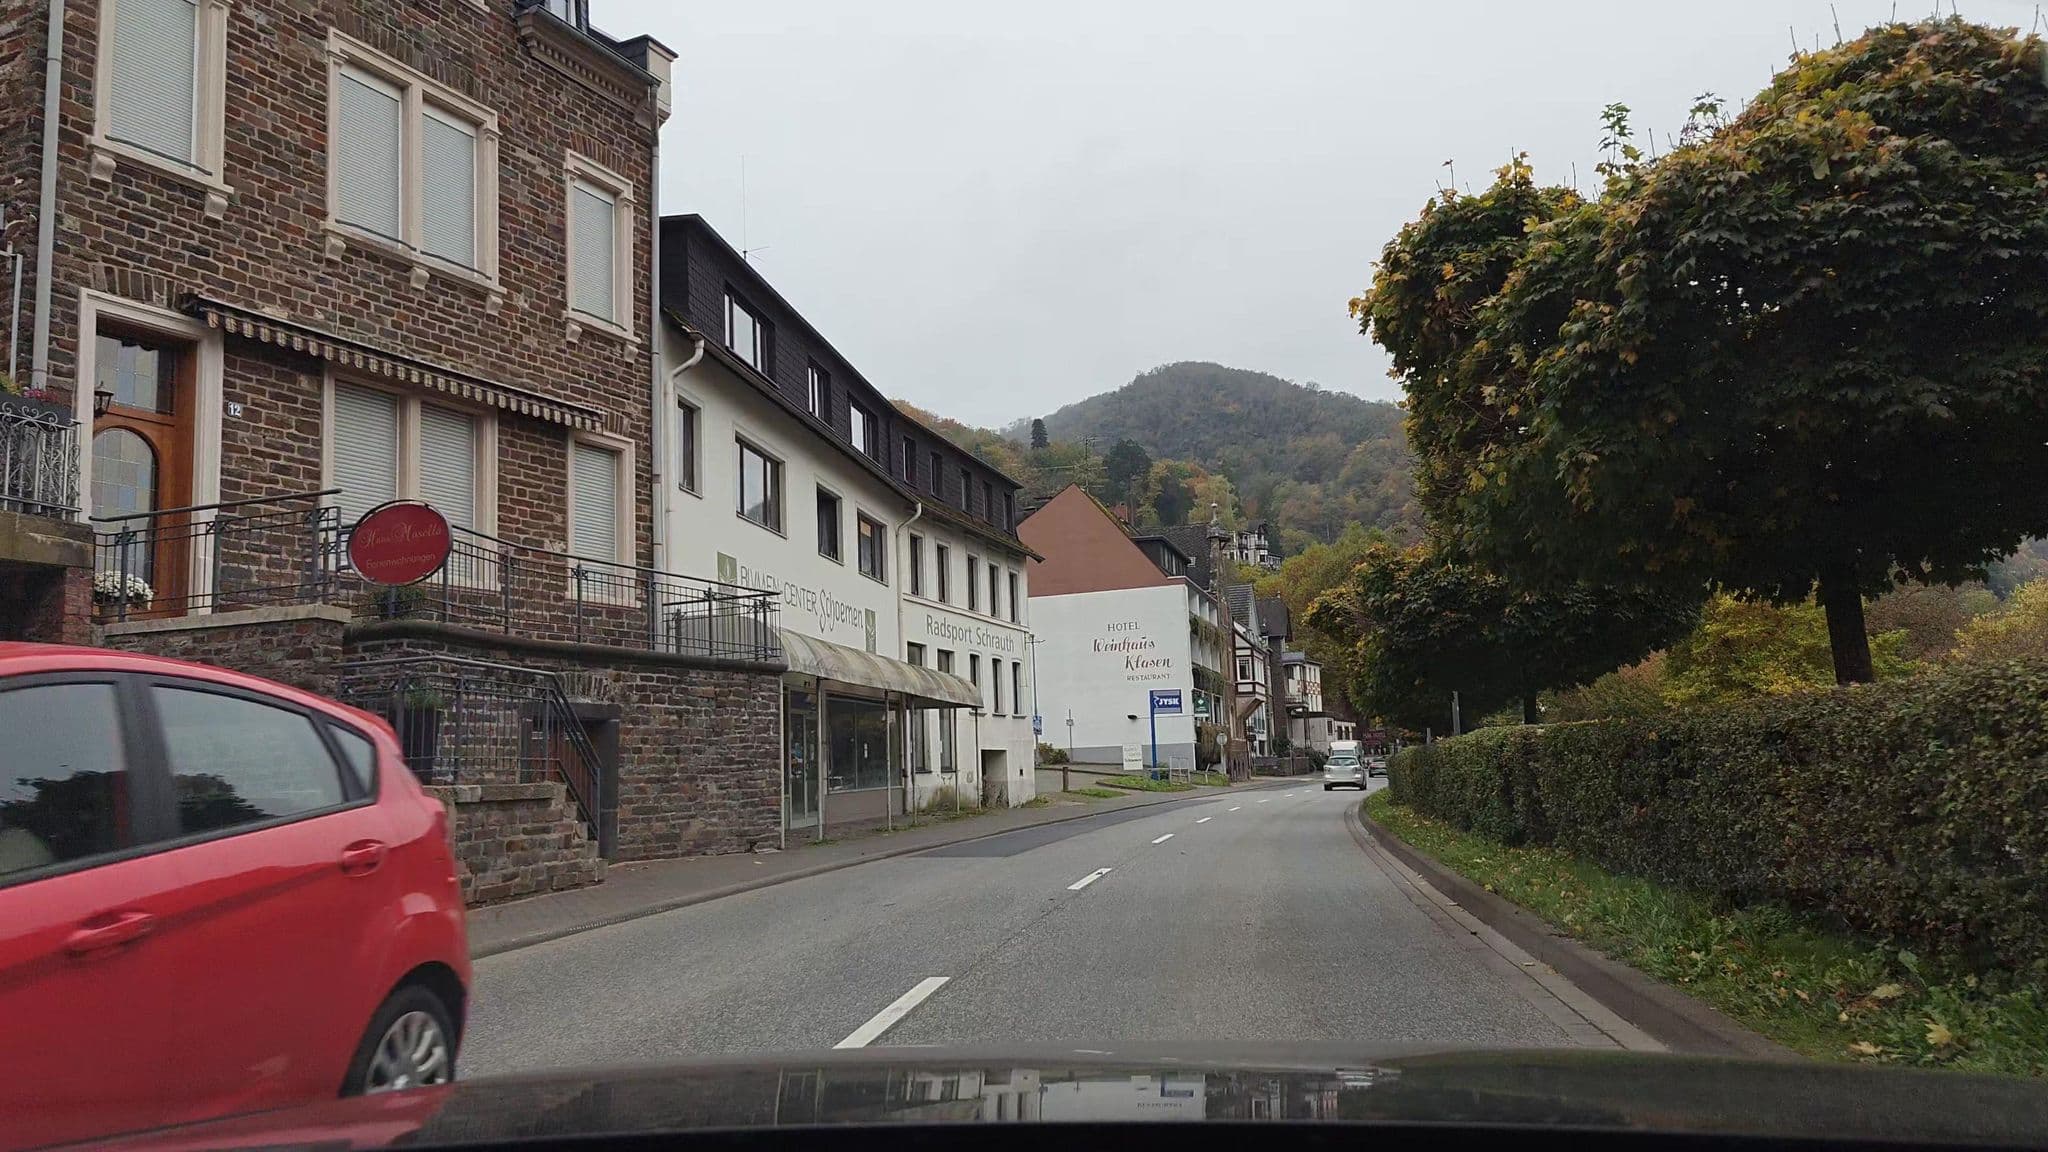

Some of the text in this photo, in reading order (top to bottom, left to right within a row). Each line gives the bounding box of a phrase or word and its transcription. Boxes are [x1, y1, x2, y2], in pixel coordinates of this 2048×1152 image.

[230, 403, 241, 416] 12
[1107, 621, 1141, 632] HOTEL
[926, 614, 1015, 653] Radsport Schrauth
[1093, 636, 1156, 654] Weinhaus
[1125, 655, 1173, 671] Klasen
[1126, 673, 1171, 681] RESTAURANT
[1158, 697, 1180, 705] JYSK
